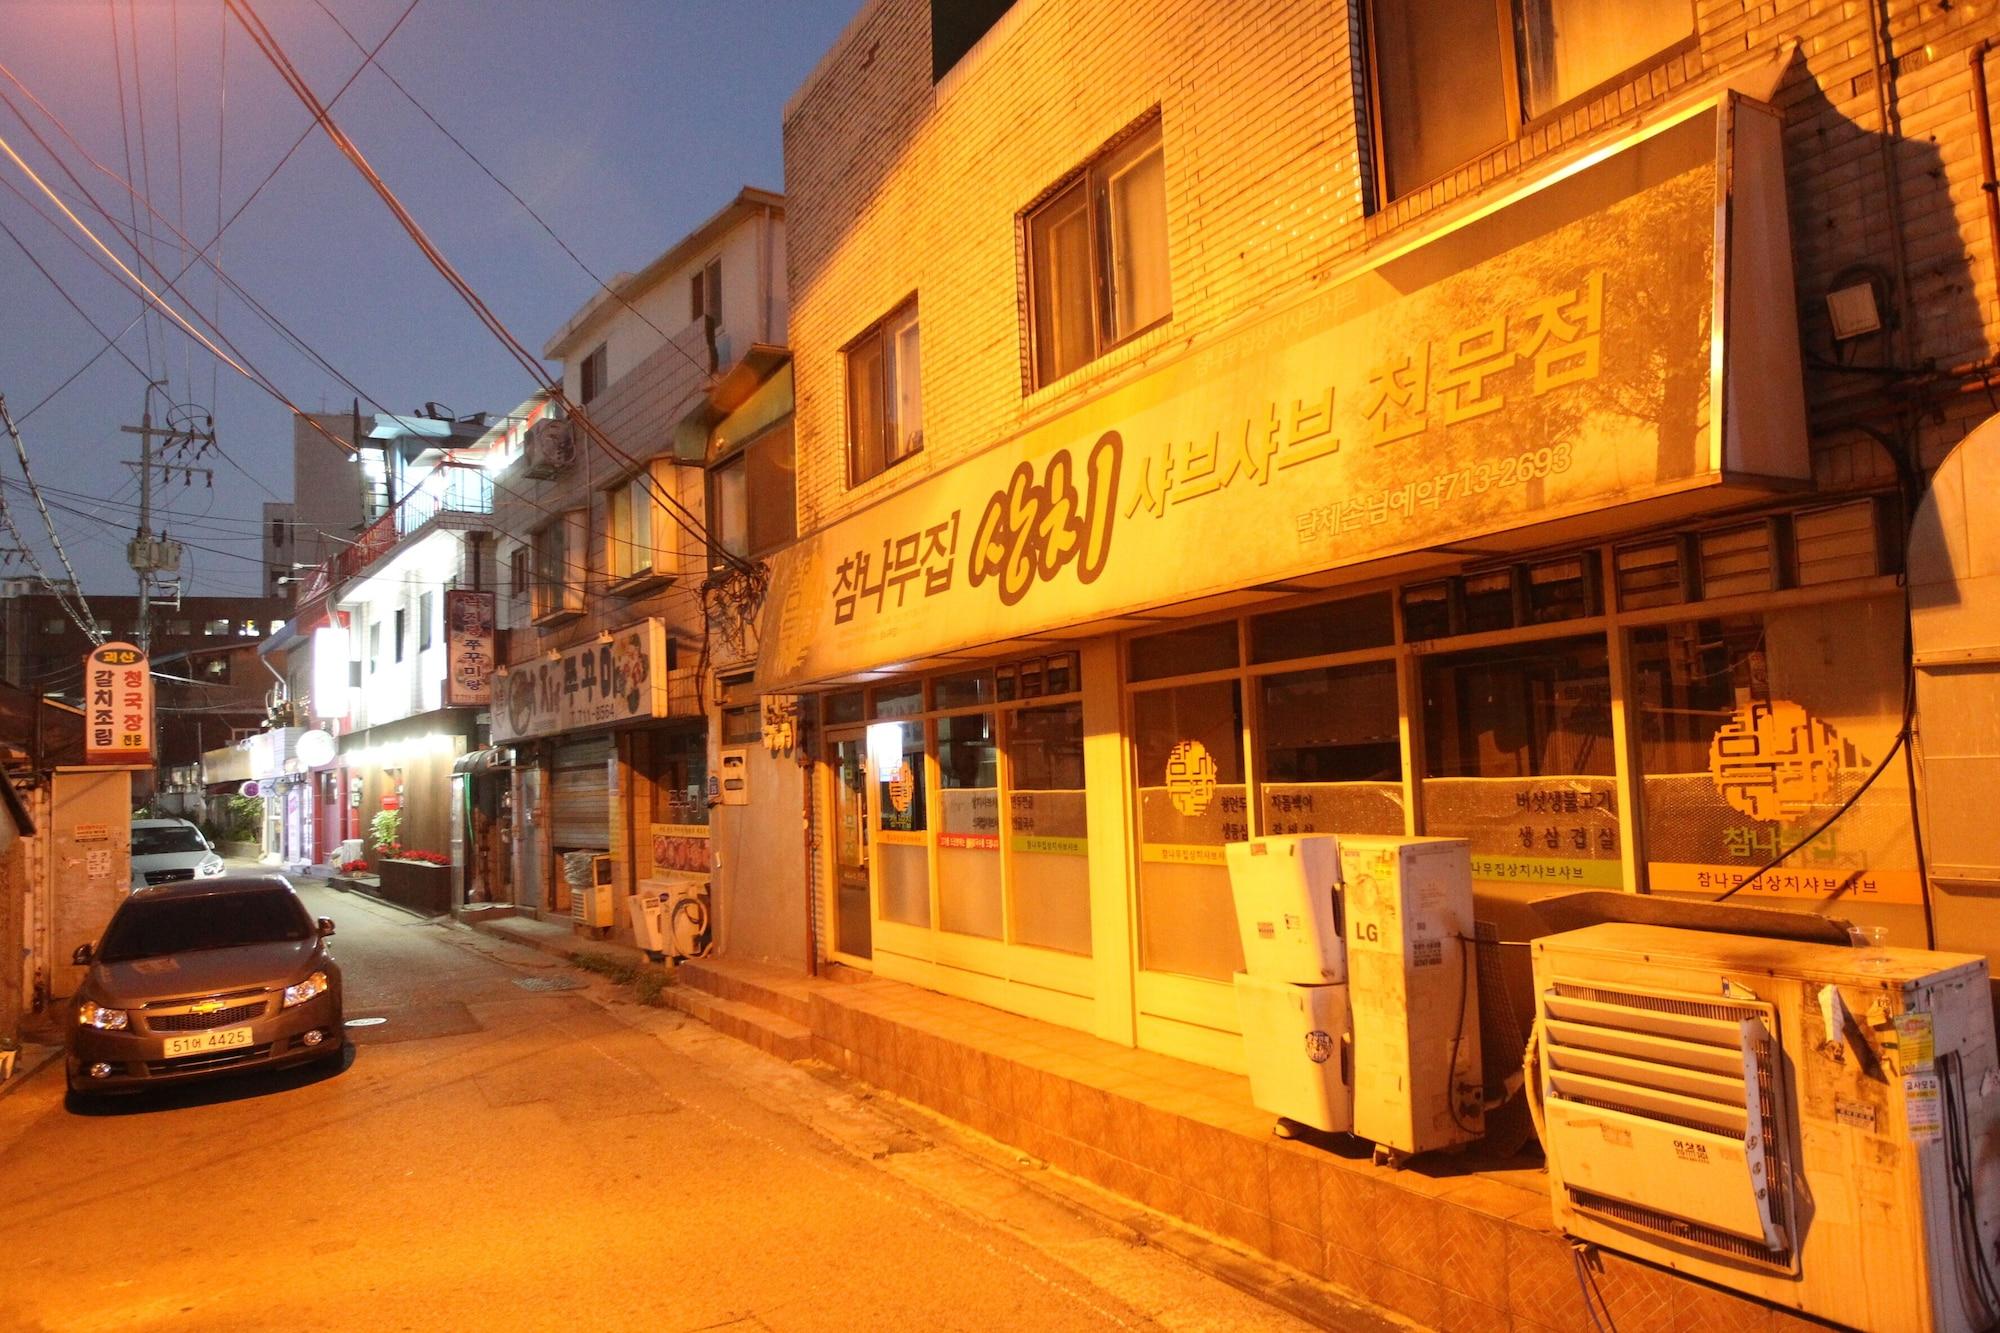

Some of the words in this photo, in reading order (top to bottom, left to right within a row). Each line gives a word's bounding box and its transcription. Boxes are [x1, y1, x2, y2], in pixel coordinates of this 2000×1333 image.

[832, 509, 961, 626] 참나무집
[967, 429, 1123, 607] 상치
[1124, 386, 1340, 520] 샤브샤브
[1362, 270, 1608, 448] 전문점
[1443, 441, 1573, 501] 713-2693
[102, 651, 135, 663] 괴산
[93, 670, 115, 747] 갈치조림
[123, 670, 144, 731] 청국장
[123, 734, 142, 746] 전문
[1516, 789, 1613, 813] 버섯생불고기
[1696, 871, 1880, 896] 참나무집상치샤브샤브
[1356, 921, 1379, 943] LG
[208, 1030, 246, 1047] 4425
